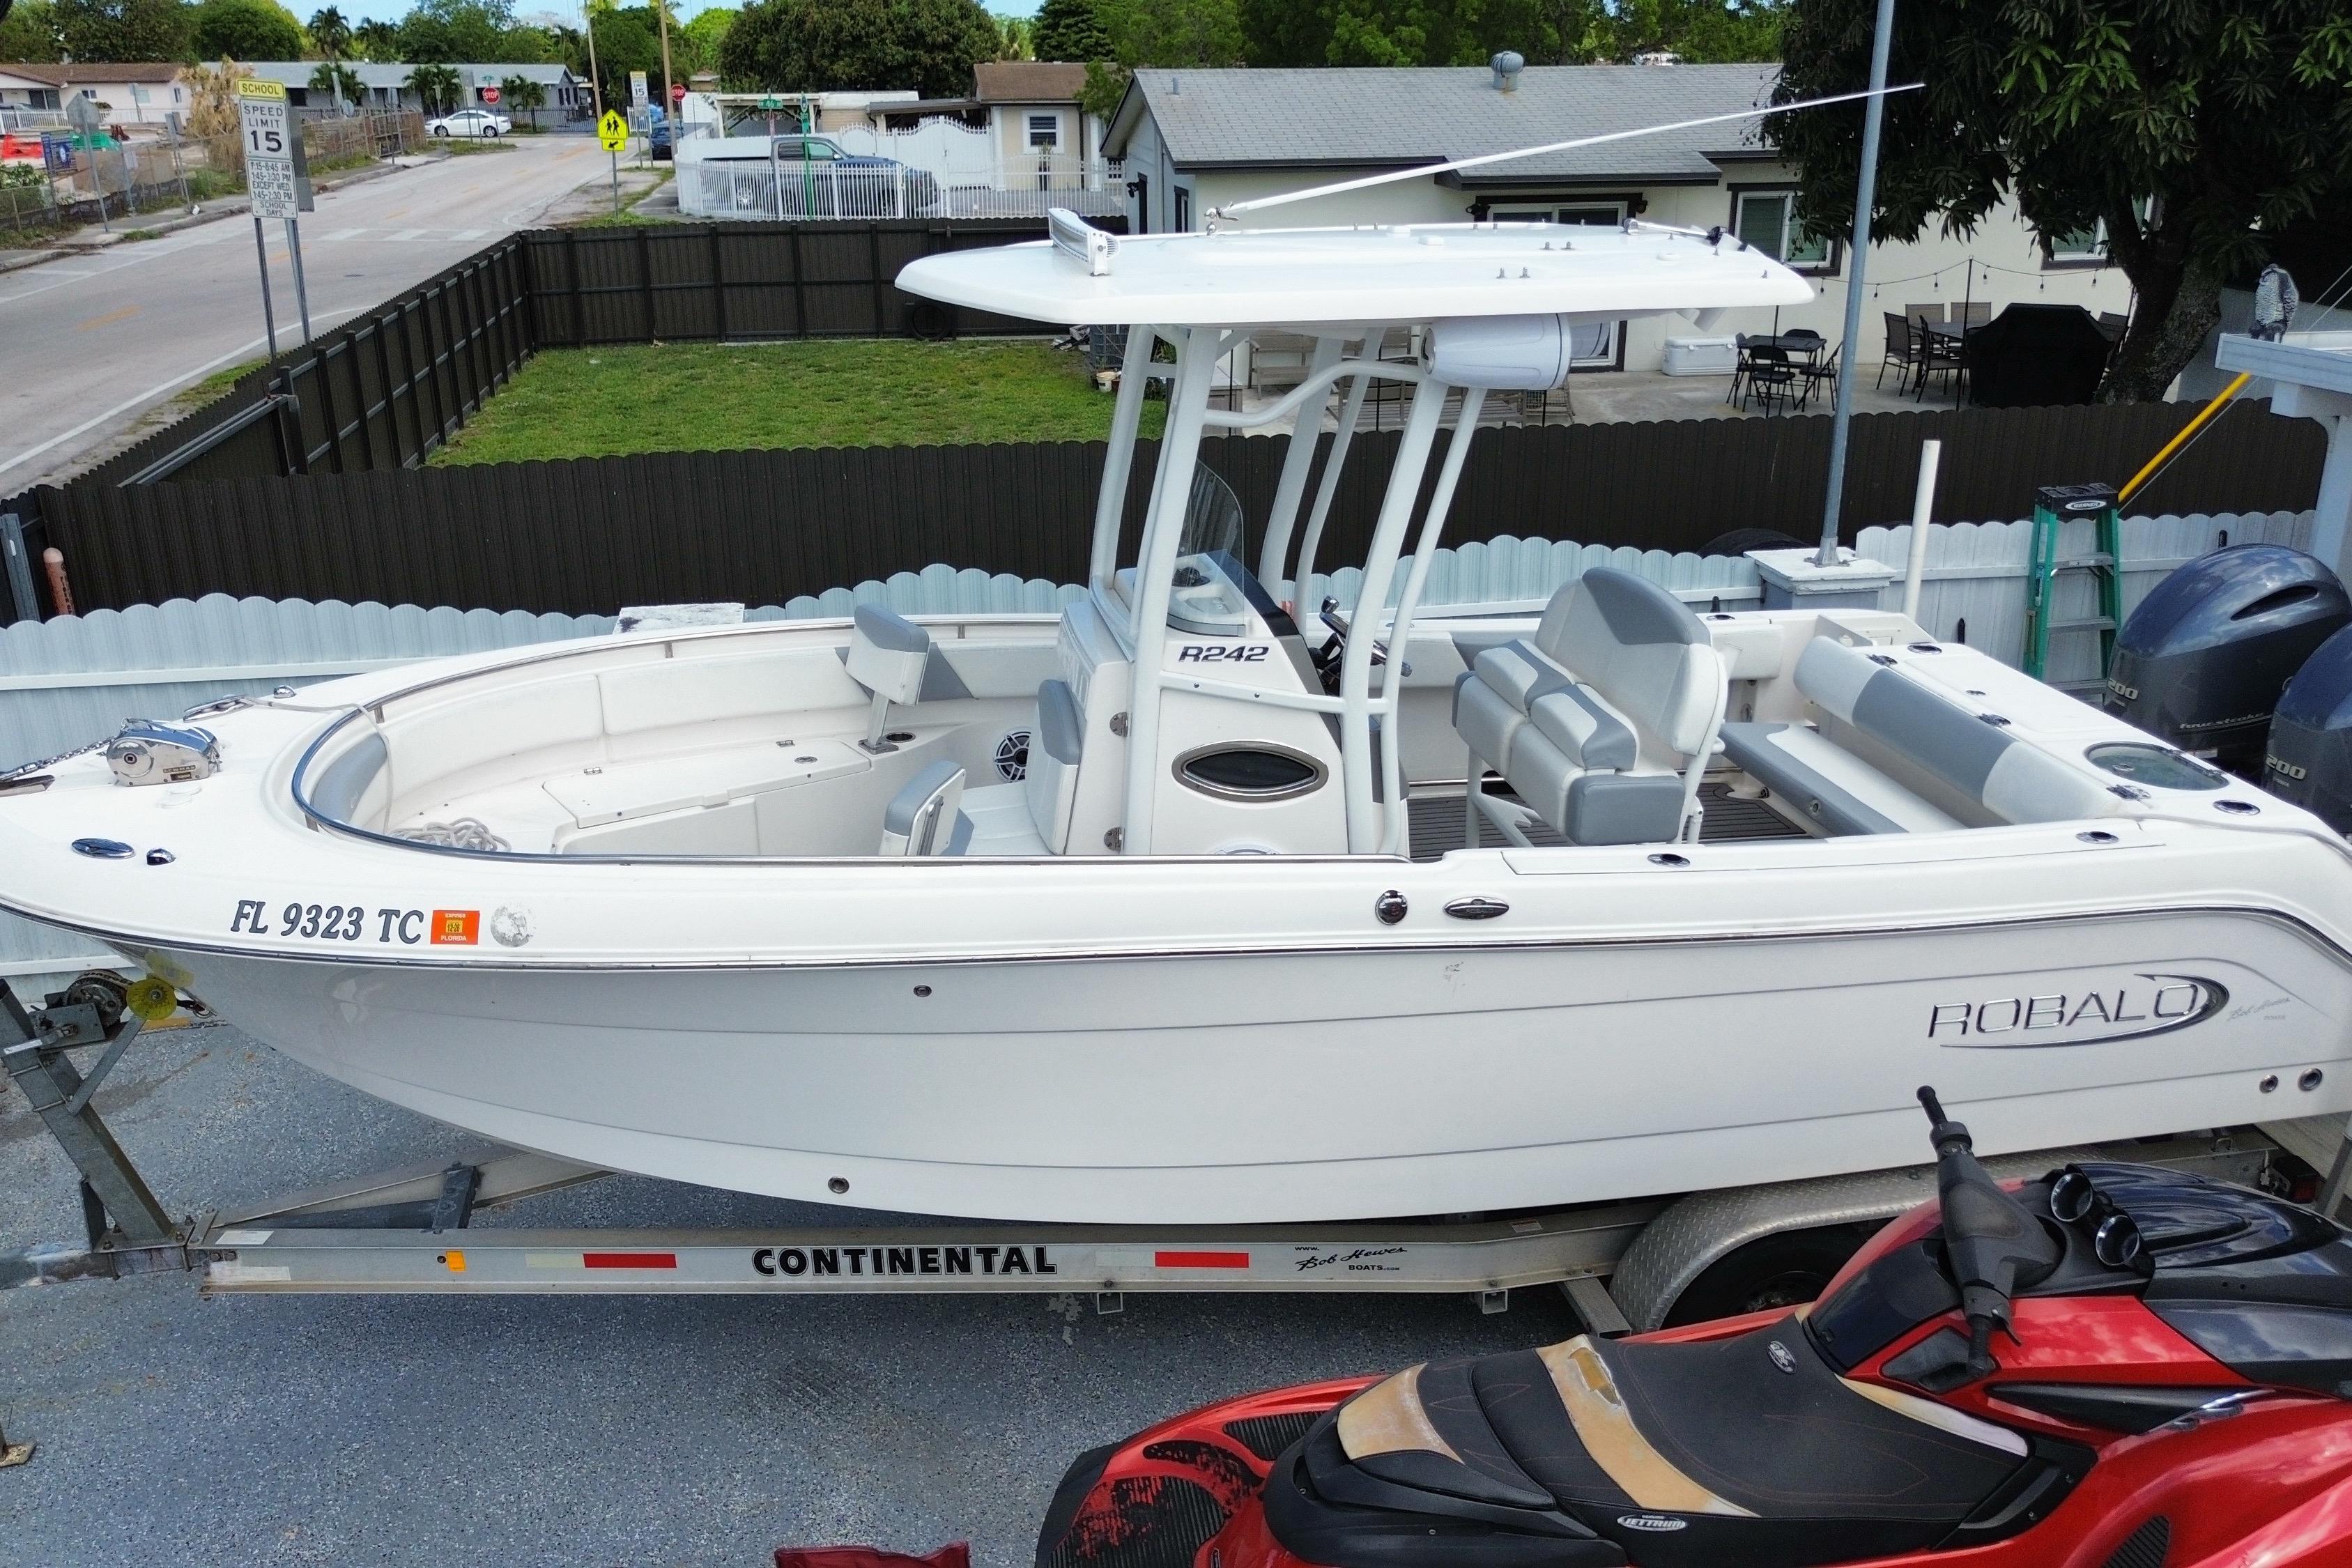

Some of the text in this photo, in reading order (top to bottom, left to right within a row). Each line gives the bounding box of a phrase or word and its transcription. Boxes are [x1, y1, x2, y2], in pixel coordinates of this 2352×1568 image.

[242, 83, 279, 95] SCHOOL
[635, 88, 645, 96] 15
[244, 105, 283, 116] SPEED
[249, 117, 280, 128] LIMIT
[251, 130, 282, 153] 15
[282, 164, 291, 172] AM
[282, 174, 291, 182] PM
[252, 181, 292, 191] EXCEPT WED.
[284, 192, 293, 200] PM
[1178, 646, 1269, 662] R242
[2108, 678, 2138, 700] 200
[2266, 753, 2306, 780] 200
[230, 900, 424, 944] FL 9323 TC
[1928, 983, 2199, 1038] ROBALO
[752, 1245, 1057, 1275] CONTINENTAL
[1295, 1247, 1408, 1271] Bob Hewes
